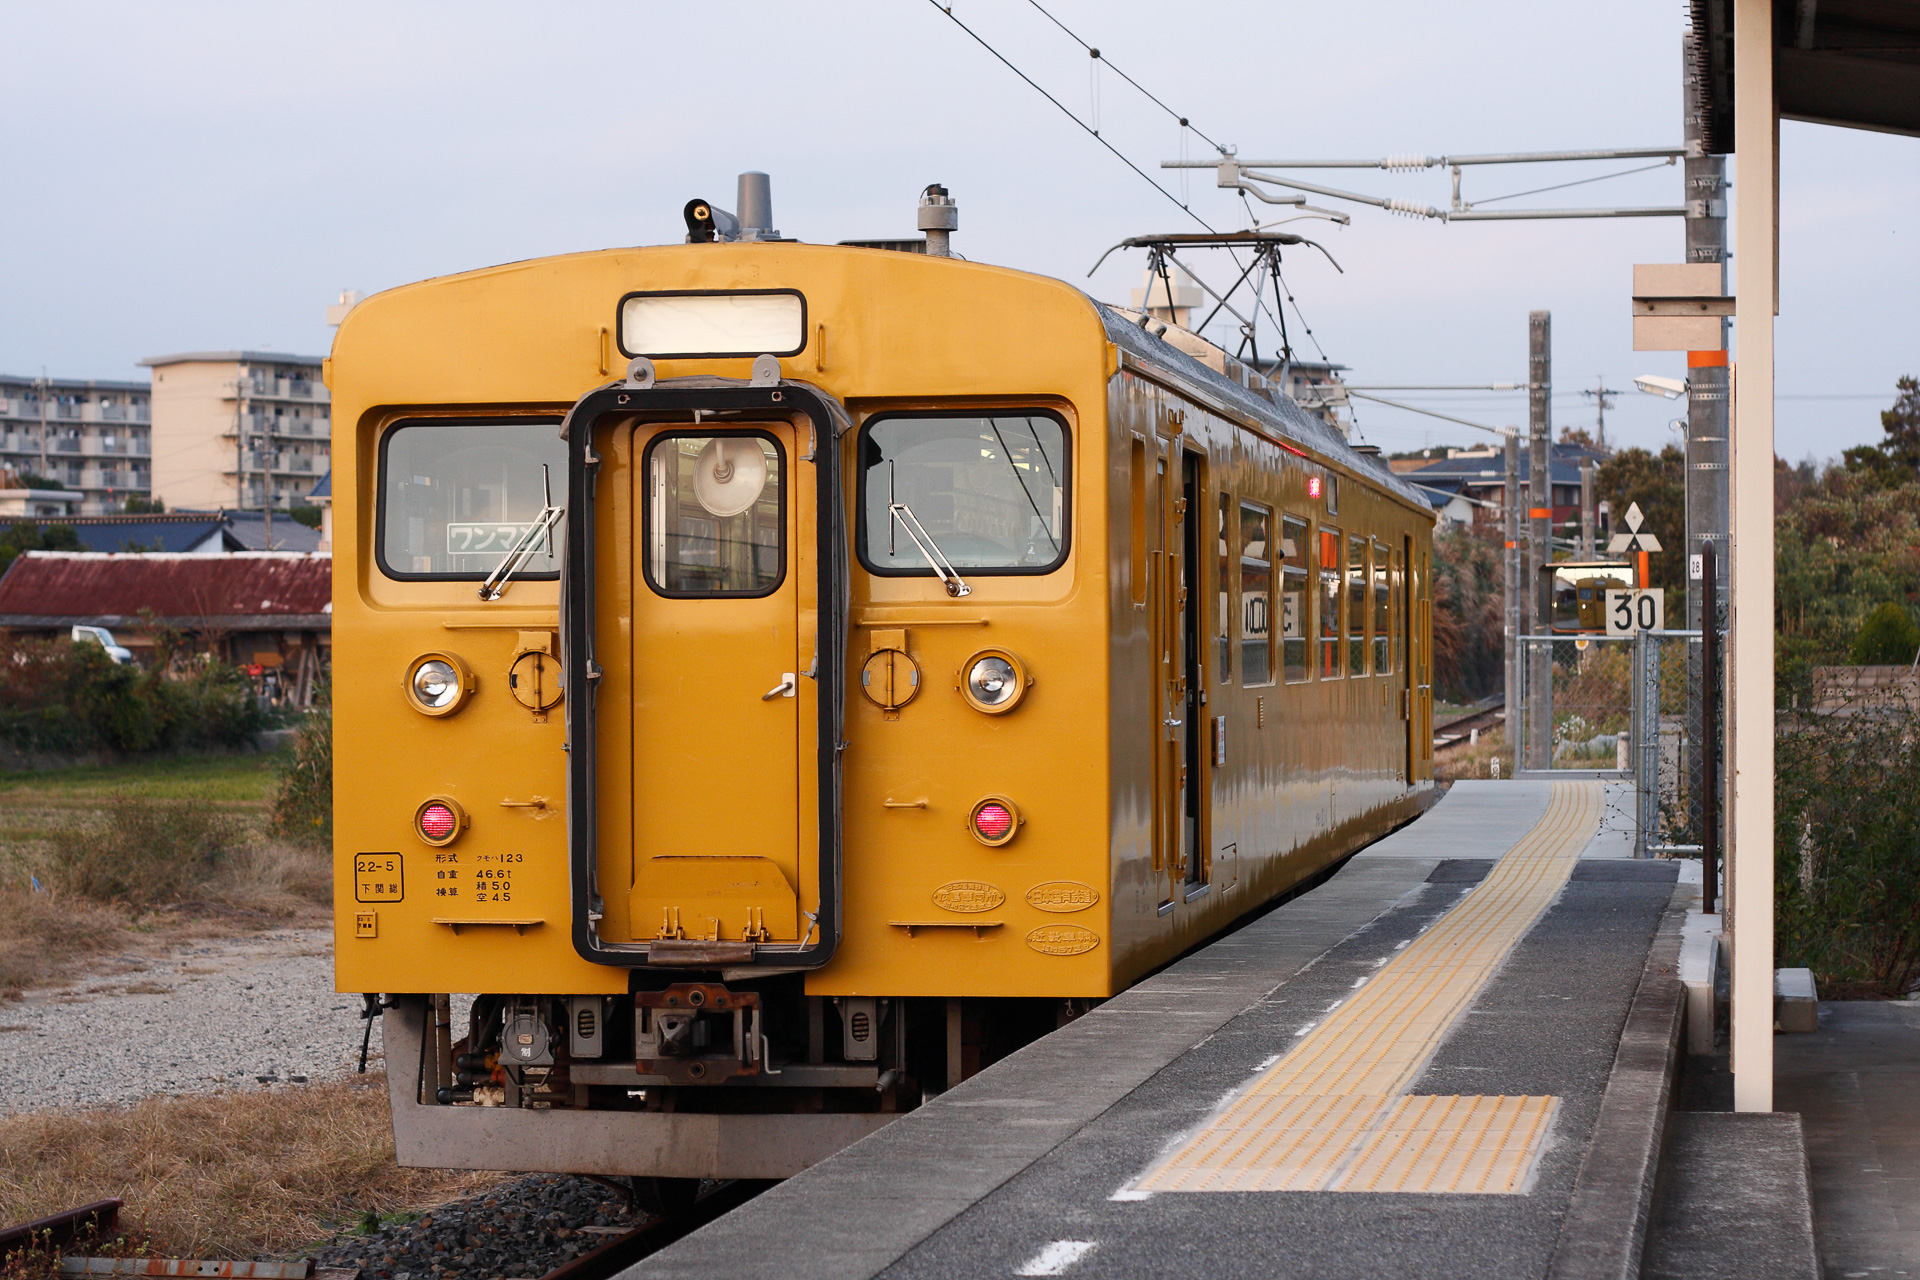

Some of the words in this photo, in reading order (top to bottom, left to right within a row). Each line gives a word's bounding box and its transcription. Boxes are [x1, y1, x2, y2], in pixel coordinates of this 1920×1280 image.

[1691, 561, 1701, 574] 28
[1614, 594, 1656, 630] 30
[435, 852, 459, 863] 形式
[357, 860, 395, 872] 22-5
[437, 869, 459, 879] 自重
[361, 883, 398, 894] 下関総
[491, 881, 511, 891] 5.0
[476, 892, 487, 902] 空
[491, 892, 511, 902] 4.5
[1033, 889, 1092, 905] 日本国有鉄道
